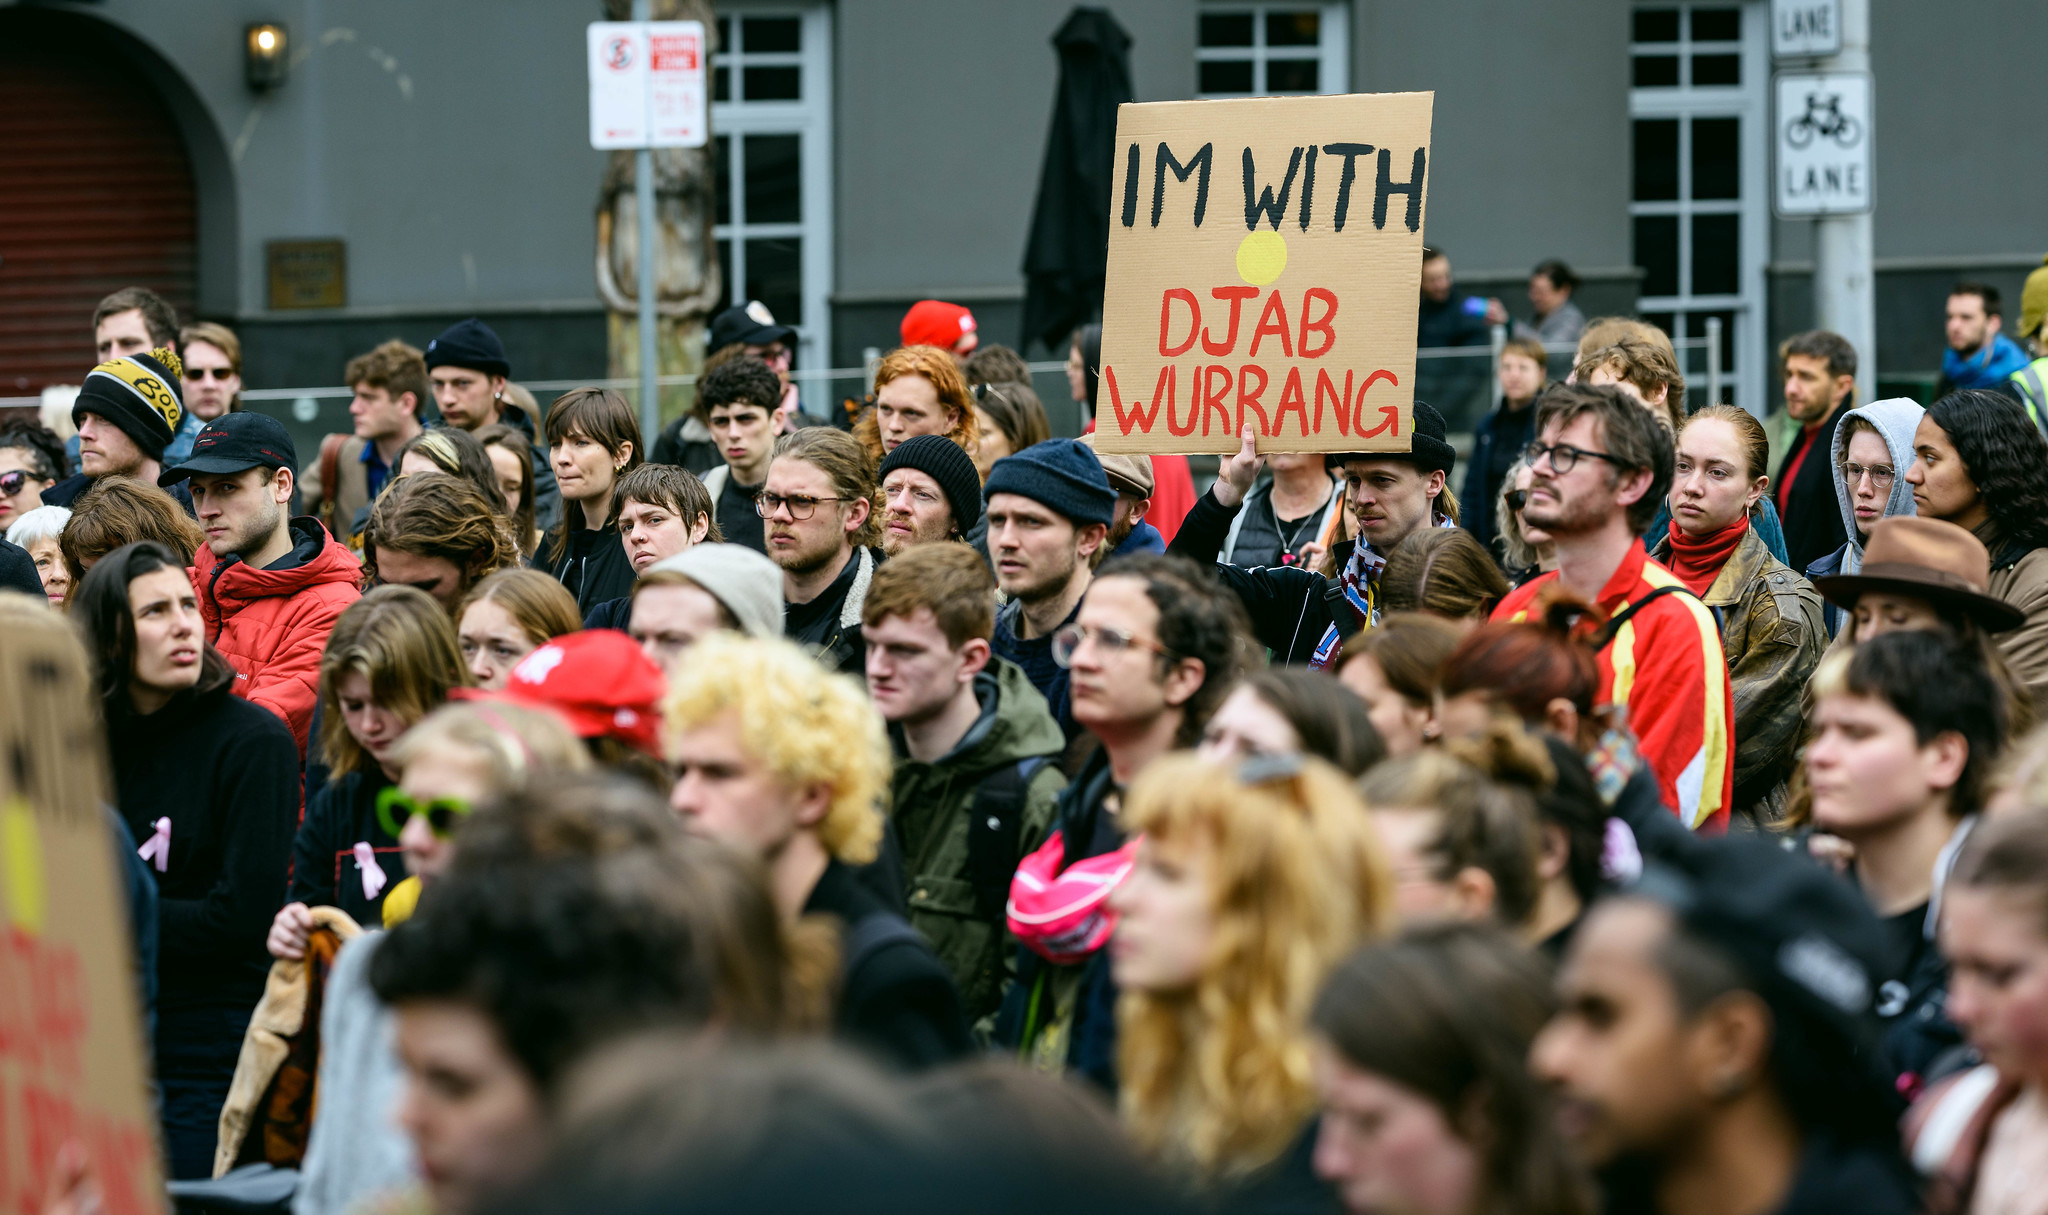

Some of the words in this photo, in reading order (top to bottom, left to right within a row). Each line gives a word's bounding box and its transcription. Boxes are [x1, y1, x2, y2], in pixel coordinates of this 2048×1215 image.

[1782, 5, 1831, 41] LANE
[1121, 141, 1213, 229] IM
[1242, 143, 1426, 232] WITH
[1787, 163, 1860, 197] LANE
[1159, 285, 1339, 359] DJAB
[1105, 364, 1399, 438] WURRANG
